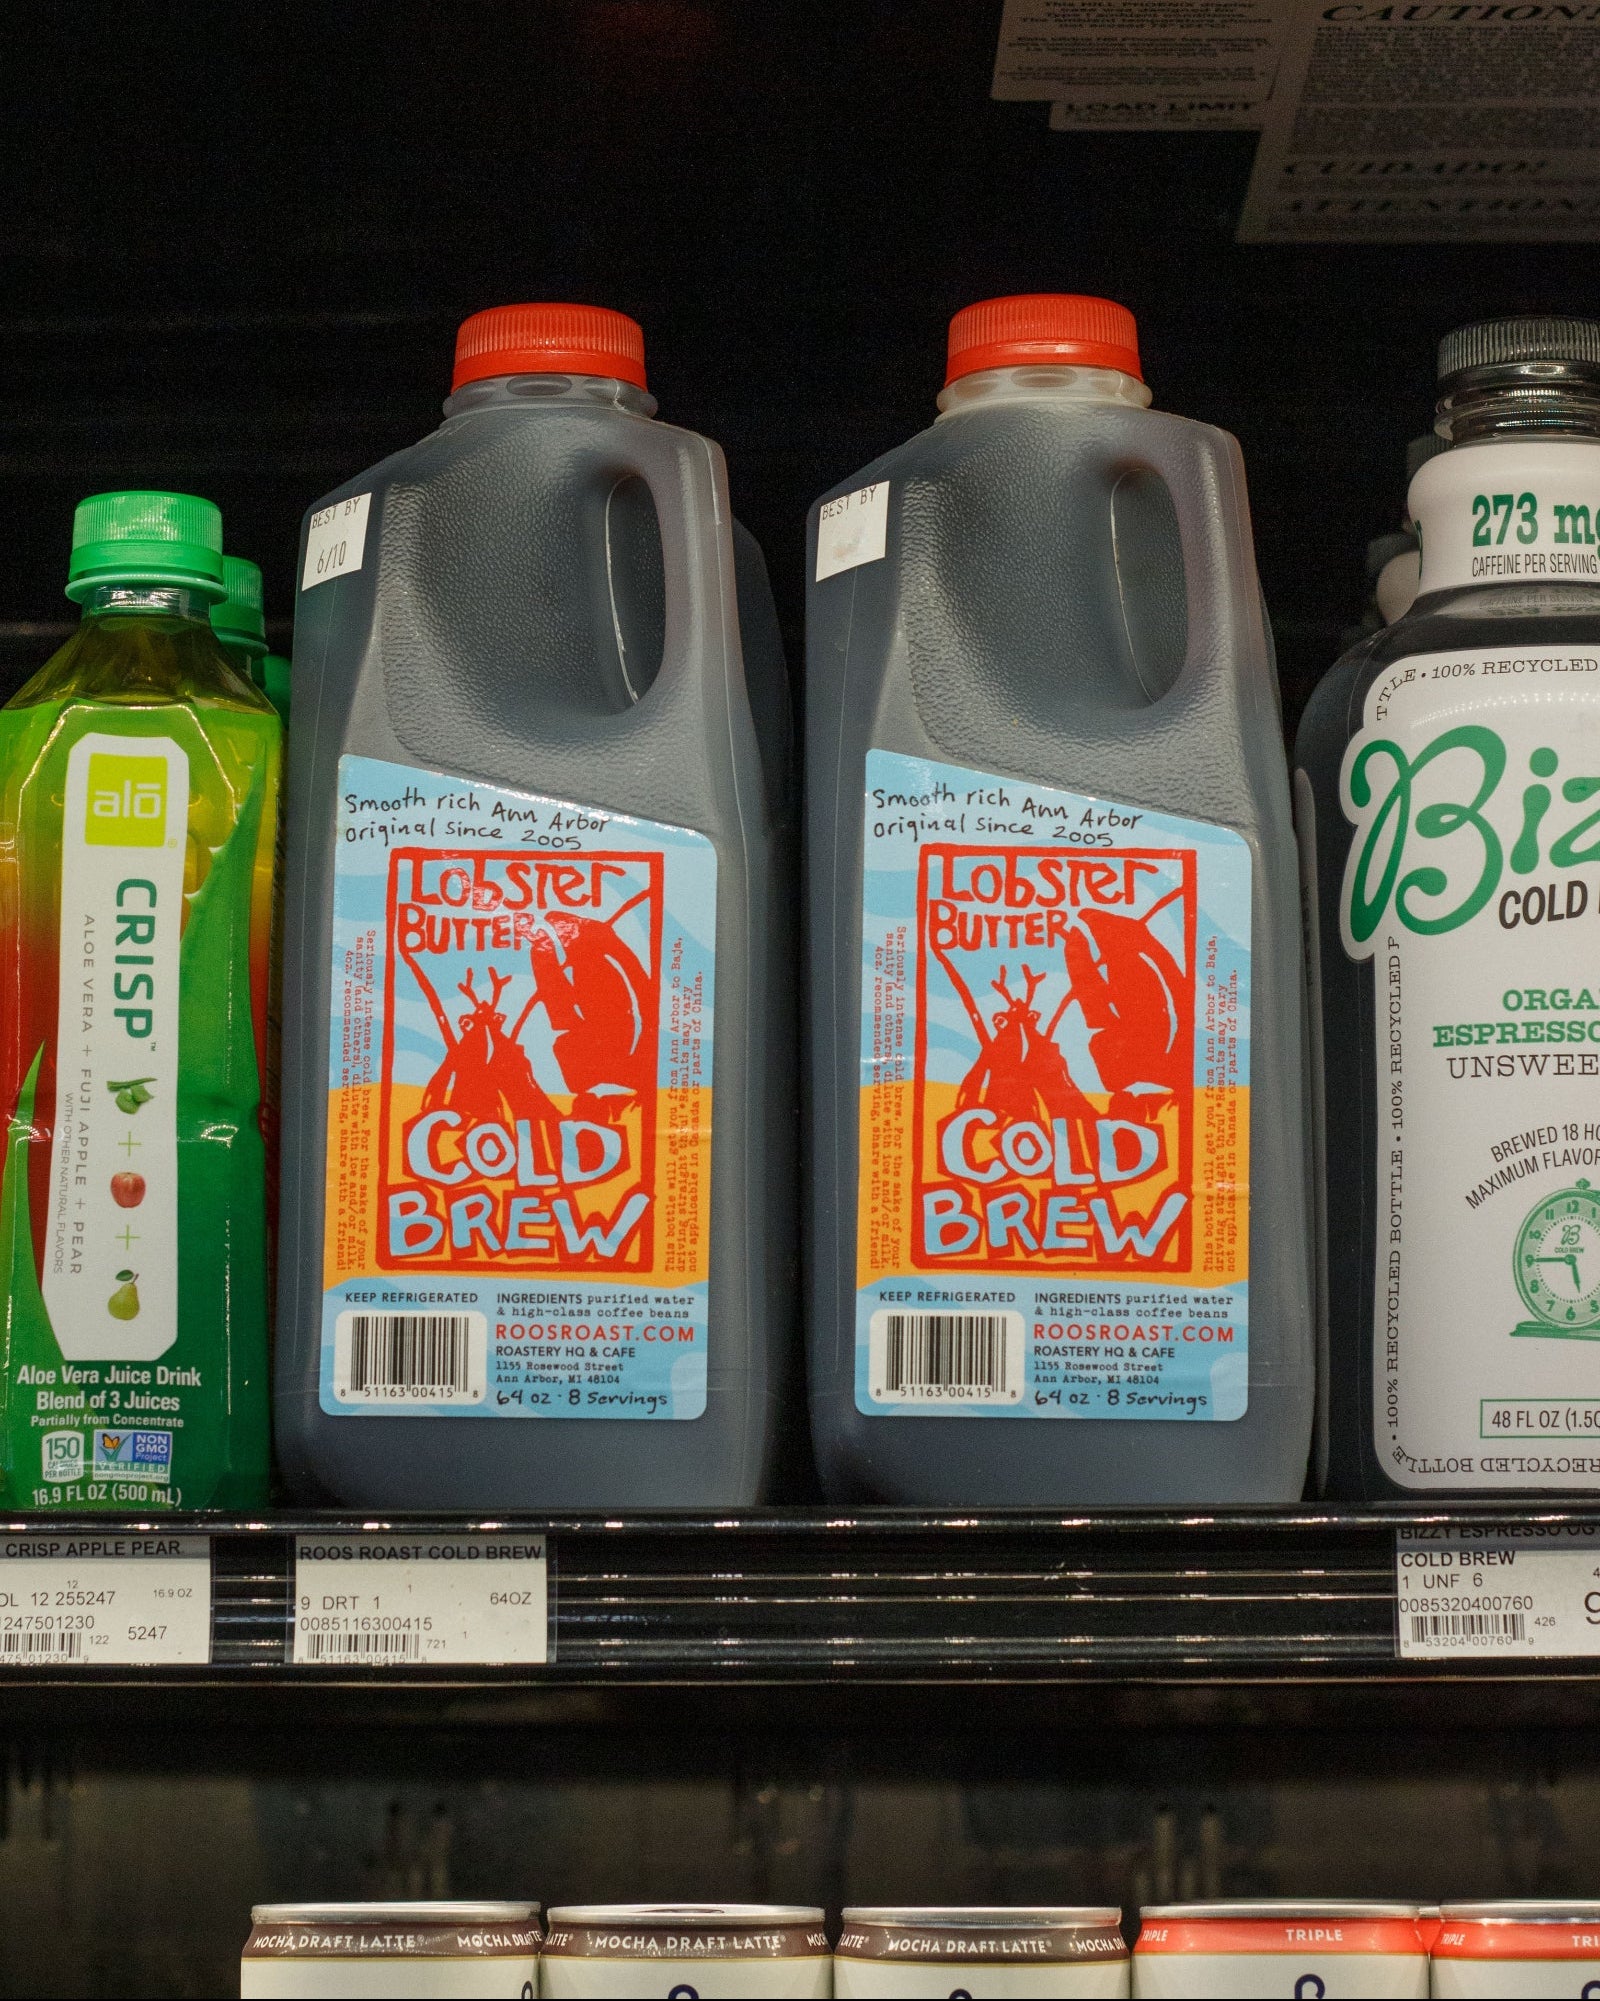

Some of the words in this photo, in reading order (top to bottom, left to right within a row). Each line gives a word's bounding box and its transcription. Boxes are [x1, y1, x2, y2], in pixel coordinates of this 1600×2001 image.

[312, 505, 338, 529] BEST
[345, 497, 360, 516] BY
[822, 495, 852, 520] BEST
[860, 485, 877, 505] BY
[1472, 492, 1538, 547] 273
[317, 540, 346, 574] 6/10
[1472, 554, 1520, 577] CAFFEINE
[1525, 553, 1546, 574] PER
[1550, 553, 1598, 574] SERVING
[1431, 663, 1475, 679] 100%
[1482, 658, 1598, 675] RECYCLED
[345, 787, 426, 813] Smooth
[437, 793, 480, 811] rich
[492, 801, 537, 823] Ann
[549, 814, 609, 833] Arbor
[873, 782, 956, 809] Smooth
[967, 788, 1010, 808] rich
[1022, 797, 1068, 819] Ann
[1080, 809, 1143, 829] Arbor
[345, 817, 435, 846] original
[521, 829, 581, 850] 2005
[874, 813, 965, 842] original
[1052, 825, 1114, 847] 2005
[1499, 879, 1587, 930] COLD
[400, 903, 535, 953] BUTTER
[930, 900, 1070, 950] BUTTER
[83, 914, 95, 968] ALOE
[113, 879, 157, 1039] CRISP
[365, 930, 376, 993] Seriously
[81, 978, 94, 1033] VERA
[1388, 956, 1402, 1074] RECYCLED
[363, 1056, 372, 1083] cold
[80, 1068, 91, 1112] FUJI
[64, 1093, 74, 1126] WITH
[1391, 1080, 1403, 1130] 100%
[74, 1121, 90, 1186] APPLE
[408, 1110, 622, 1186] COLD
[942, 1109, 1159, 1186] COLD
[1490, 1125, 1558, 1163] BREWED
[1561, 1124, 1579, 1141] 18
[1464, 1155, 1540, 1210] MAXIMUM
[1390, 1150, 1403, 1244] BOTTLE
[389, 1191, 650, 1257] BREW
[923, 1191, 1188, 1257] BREW
[54, 1219, 66, 1275] FLAVORS
[70, 1221, 85, 1274] PEAR
[345, 1292, 378, 1303] KEEP
[382, 1292, 478, 1303] REFRIGERATED
[497, 1293, 582, 1305] INGREDIENTS
[587, 1293, 649, 1307] purified
[654, 1295, 695, 1306] water
[879, 1292, 911, 1301] KEEP
[917, 1292, 1016, 1302] REFRIGERATED
[1035, 1293, 1121, 1305] INGREDIENTS
[1125, 1293, 1189, 1307] purified
[1193, 1295, 1234, 1306] water
[511, 1307, 591, 1320] high-class
[597, 1307, 643, 1318] coffee
[650, 1308, 690, 1319] beans
[1387, 1251, 1400, 1372] RECYCLED
[496, 1324, 695, 1342] ROOSROAST.COM
[1034, 1323, 1234, 1343] ROOSROAST.COM
[496, 1346, 561, 1358] ROASTERY
[565, 1346, 585, 1358] HQ
[602, 1347, 635, 1359] CAFE
[17, 1365, 57, 1385] Aloe
[61, 1365, 100, 1385] Vera
[104, 1365, 152, 1386] Juice
[156, 1366, 202, 1387] Drink
[527, 1361, 580, 1372] Rosewood
[584, 1361, 624, 1372] Street
[496, 1374, 520, 1384] Ann
[37, 1390, 85, 1411] Blend
[89, 1391, 106, 1410] of
[109, 1392, 120, 1410] 3
[123, 1391, 181, 1412] Juices
[364, 1386, 406, 1398] 51163
[411, 1386, 453, 1398] 00415
[496, 1390, 524, 1405] 64
[530, 1392, 552, 1404] oz
[568, 1389, 581, 1405] 8
[587, 1390, 668, 1414] Servings
[1035, 1390, 1062, 1406] 64
[1069, 1392, 1091, 1405] oz
[1107, 1389, 1120, 1406] 8
[1126, 1390, 1208, 1414] Servings
[1387, 1378, 1398, 1428] 100%
[30, 1413, 82, 1428] Partially
[83, 1413, 110, 1426] from
[112, 1413, 184, 1428] Concentrate
[1491, 1411, 1511, 1428] 48
[1517, 1410, 1535, 1428] FL
[1539, 1410, 1560, 1428] OZ
[45, 1436, 81, 1460] 150
[135, 1444, 168, 1454] GMO
[136, 1434, 168, 1445] NON
[99, 1462, 166, 1472] VERIFIED
[135, 1453, 168, 1462] Project
[32, 1487, 62, 1506] 16.9
[66, 1485, 84, 1502] FL
[87, 1484, 107, 1500] OZ
[111, 1483, 148, 1502] (500
[151, 1487, 182, 1507] mL)
[6, 1543, 60, 1558] CRISP
[66, 1542, 125, 1557] APPLE
[131, 1541, 181, 1556] PEAR
[300, 1546, 353, 1560] ROOS
[359, 1546, 422, 1560] ROAST
[428, 1546, 480, 1560] COLD
[486, 1546, 541, 1560] BREW
[1400, 1553, 1452, 1567] COLD
[1459, 1551, 1516, 1566] BREW
[177, 1588, 193, 1598] OZ
[1423, 1574, 1460, 1589] UNF
[31, 1593, 49, 1606] 12
[55, 1591, 116, 1606] 255247
[322, 1596, 359, 1610] DRT
[490, 1592, 532, 1606] 64OZ
[1400, 1595, 1533, 1613] 0085320400760
[128, 1625, 168, 1641] 5247
[300, 1616, 433, 1632] 0085116300415
[426, 1639, 446, 1649] 721
[254, 1934, 293, 1949] MOCHA
[299, 1934, 351, 1949] DRAFT
[360, 1934, 415, 1949] LATTE
[457, 1934, 511, 1949] MOCHA
[595, 1936, 658, 1951] MOCHA
[666, 1936, 726, 1951] DRAFT
[733, 1936, 781, 1950] LATTE
[888, 1939, 941, 1954] MOCHA
[946, 1939, 997, 1954] DRAFT
[1003, 1939, 1047, 1954] LATTE
[1286, 1928, 1343, 1942] TRIPLE
